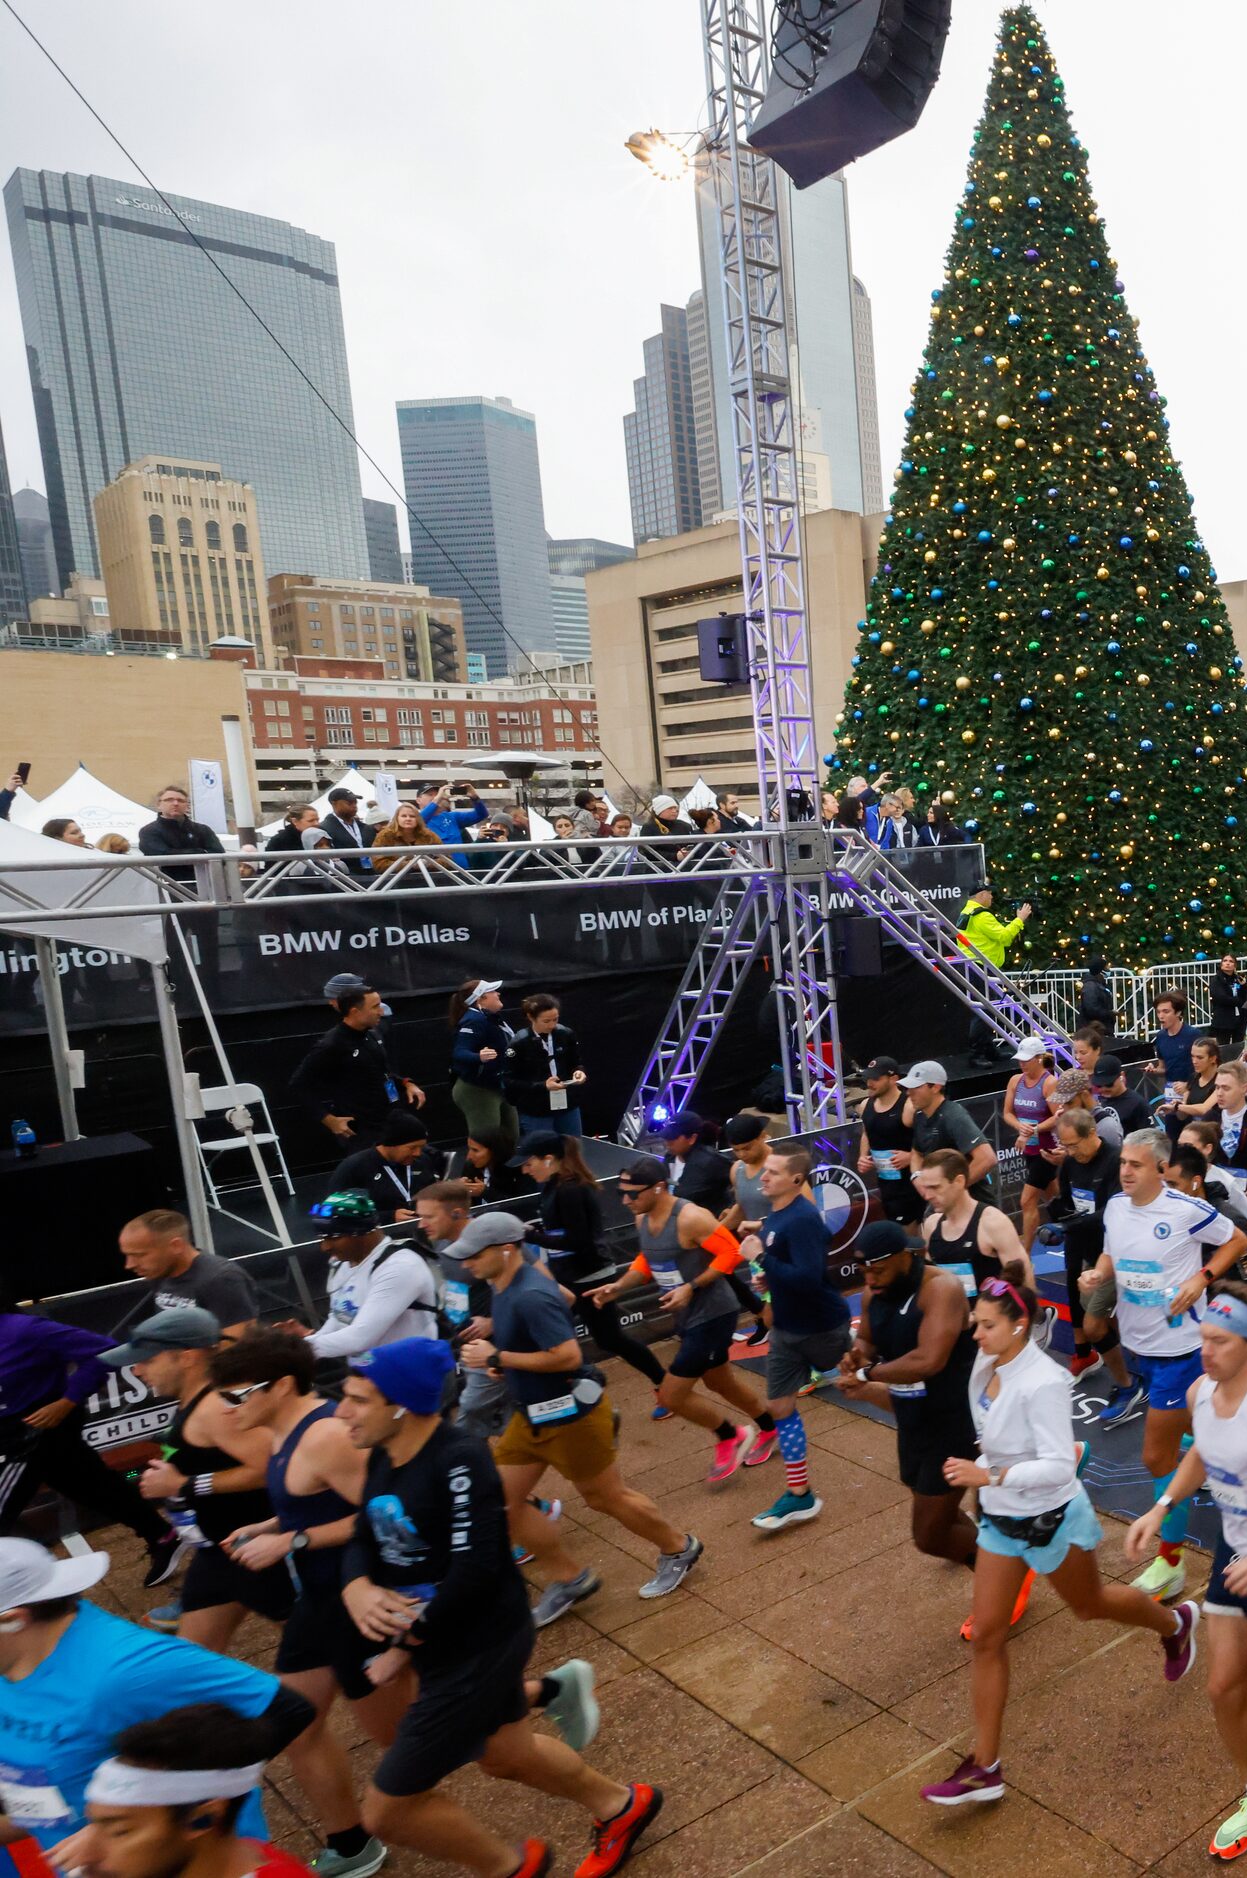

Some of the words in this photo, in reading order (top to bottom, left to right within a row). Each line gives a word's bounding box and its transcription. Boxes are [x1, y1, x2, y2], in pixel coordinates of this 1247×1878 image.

[133, 198, 201, 222] Santander
[579, 909, 641, 932] BMW
[647, 907, 669, 926] of
[258, 930, 342, 956] BMW
[349, 927, 379, 949] of
[385, 924, 470, 947] Dallas
[1001, 1168, 1029, 1186] FEST
